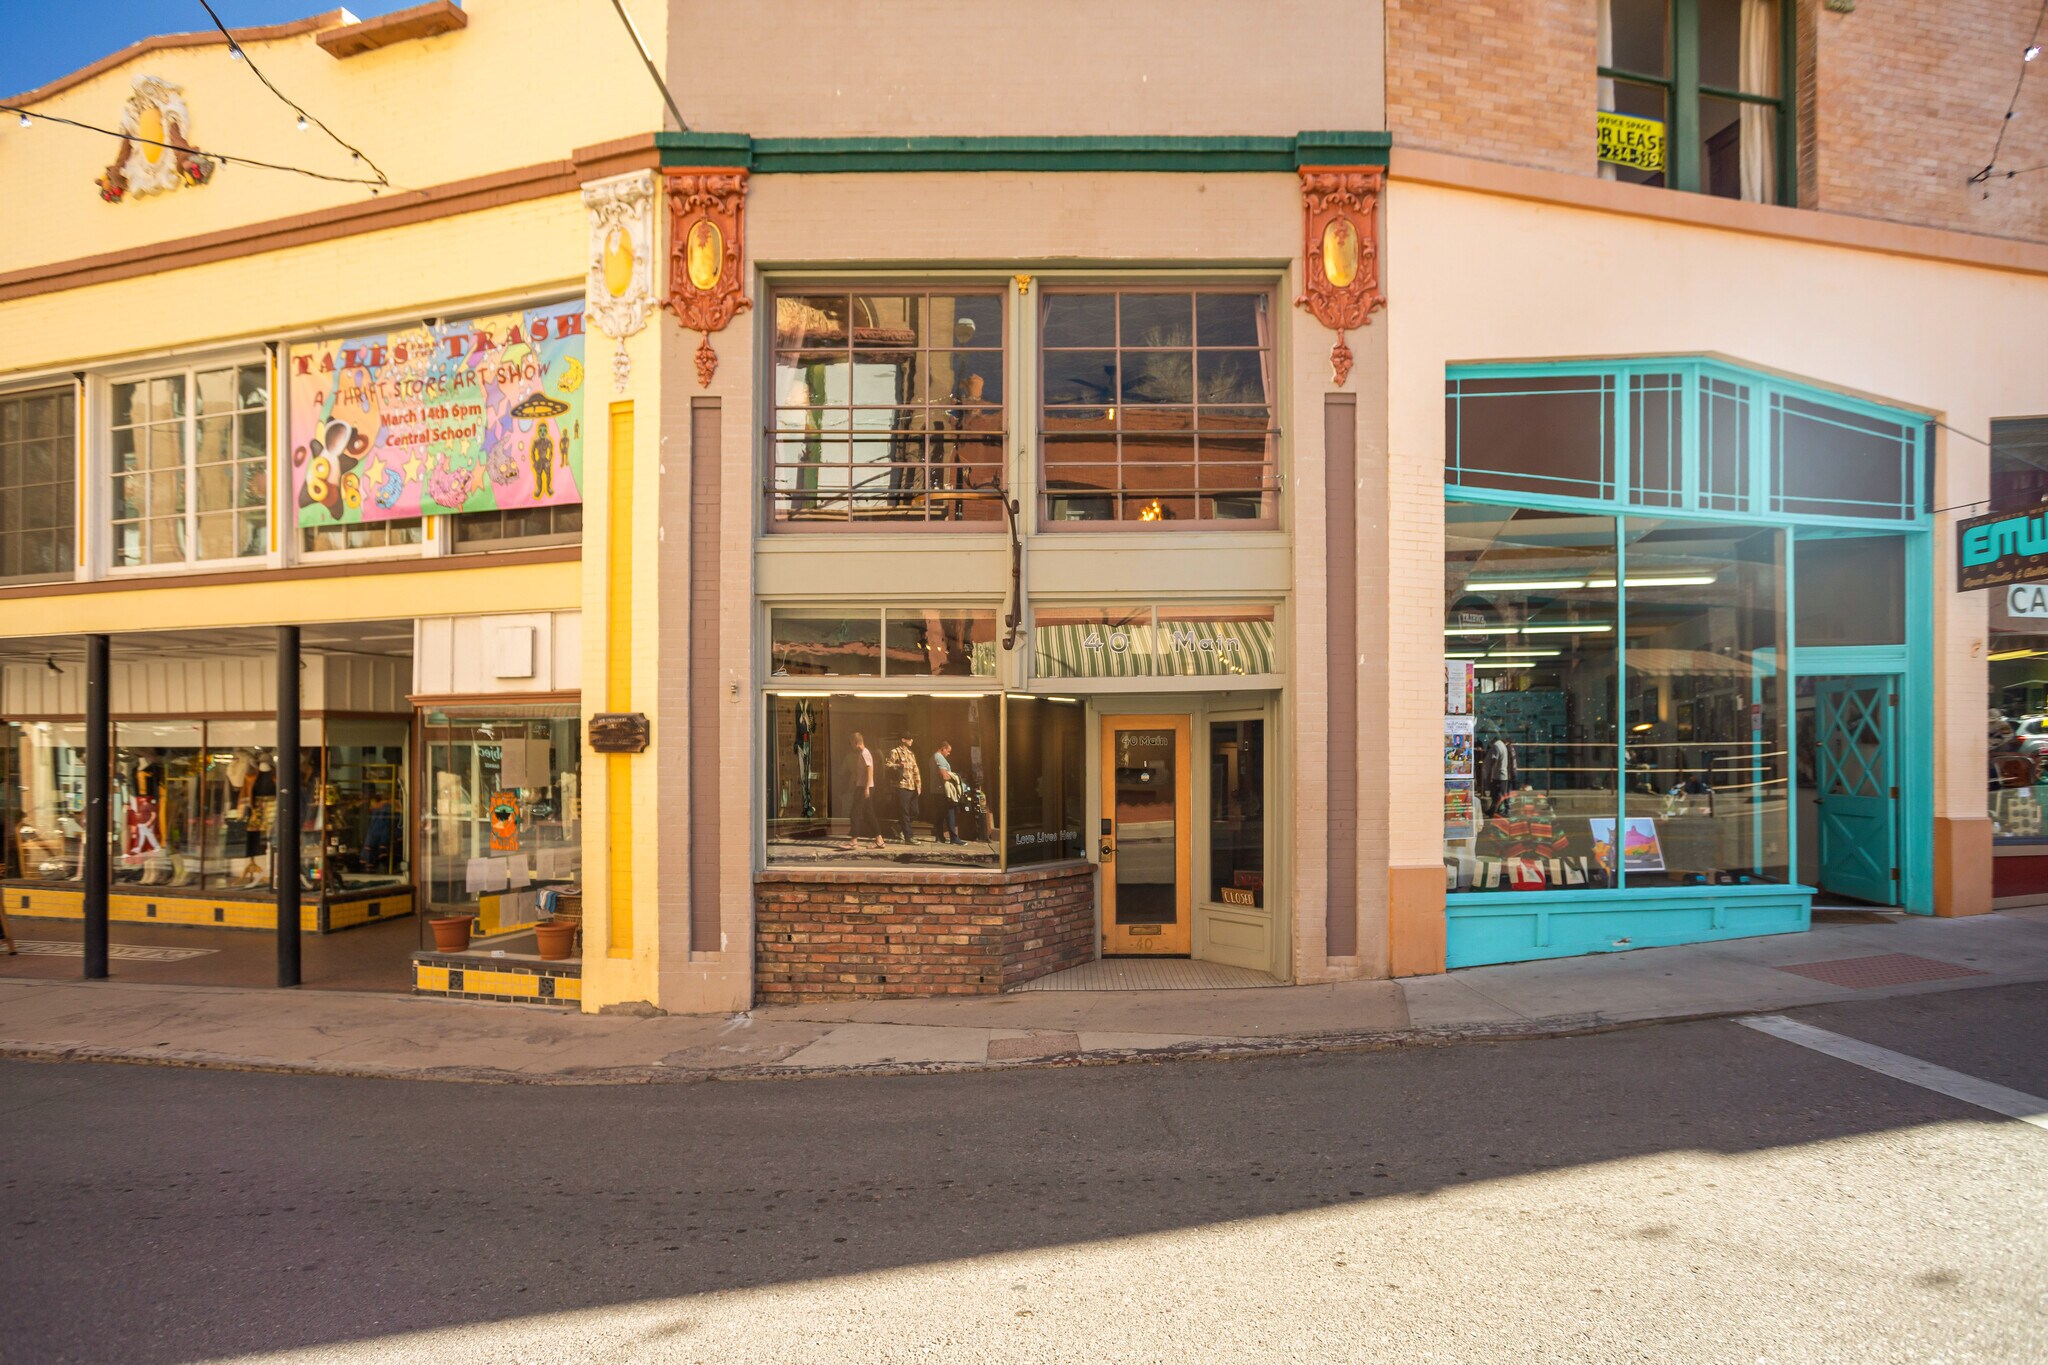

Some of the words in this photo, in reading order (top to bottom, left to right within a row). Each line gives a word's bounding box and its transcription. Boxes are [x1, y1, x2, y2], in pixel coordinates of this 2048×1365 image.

[292, 342, 409, 377] TALES
[442, 311, 586, 360] TRASH
[313, 391, 324, 406] A
[334, 382, 386, 406] THRIFT
[394, 373, 448, 398] STORE
[453, 367, 487, 389] ART
[497, 361, 551, 385] SHOW
[380, 411, 417, 428] March
[420, 406, 449, 424] 14th
[452, 403, 482, 421] 6pm
[385, 429, 431, 448] Central
[432, 423, 478, 443] School
[1084, 632, 1130, 653] 40
[1172, 631, 1240, 653] Main
[1121, 735, 1138, 746] 40
[1139, 735, 1168, 746] Main
[1015, 833, 1036, 845] Love
[1037, 831, 1057, 843] Lives
[1060, 829, 1078, 841] Here
[1224, 890, 1254, 905] CLOSED
